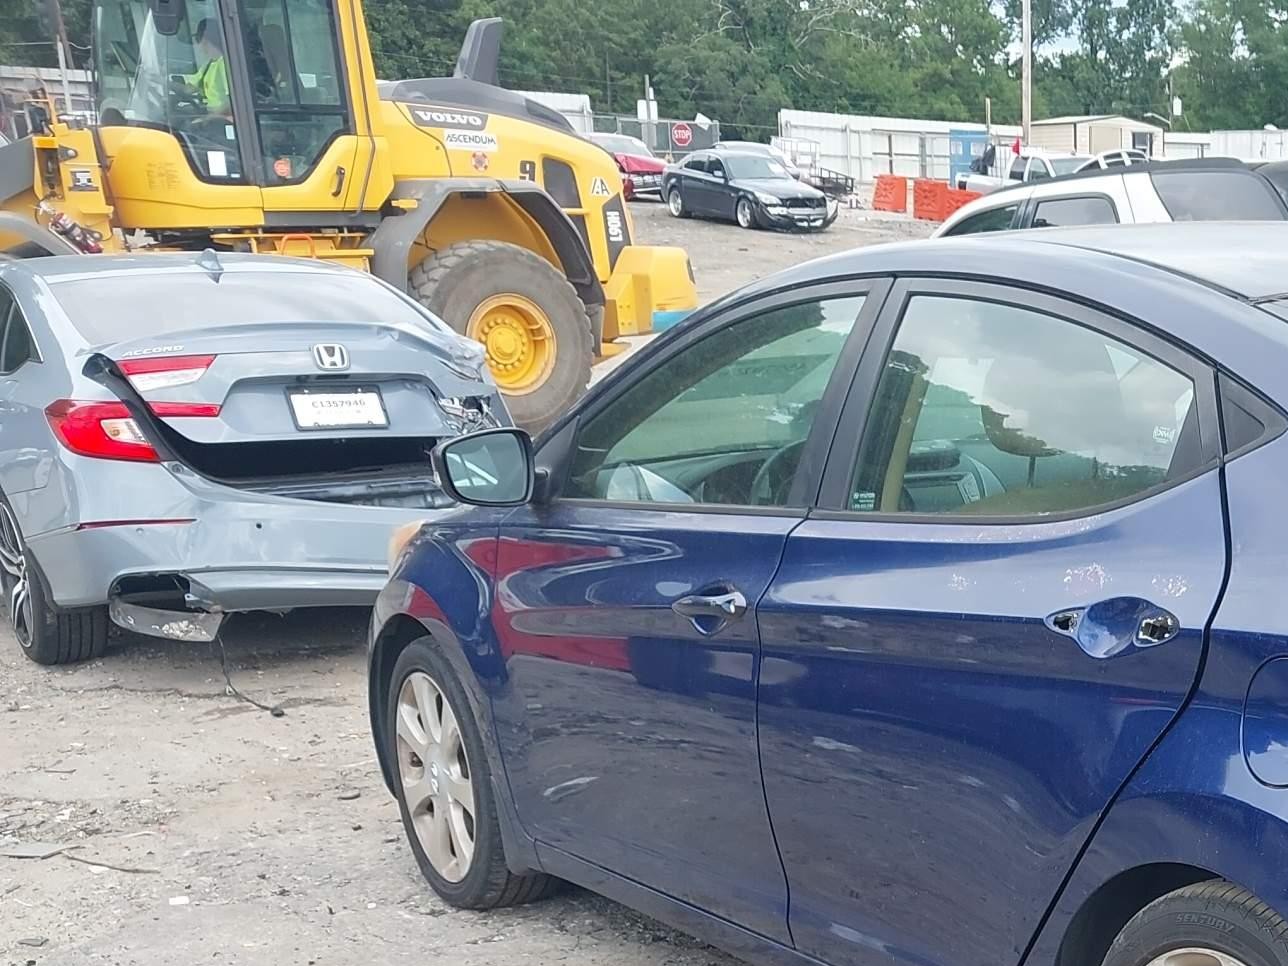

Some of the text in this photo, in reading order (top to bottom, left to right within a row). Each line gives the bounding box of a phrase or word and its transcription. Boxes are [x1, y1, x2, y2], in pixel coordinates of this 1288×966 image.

[414, 110, 482, 126] VOLVO
[446, 133, 497, 145] ASCENDUM
[674, 129, 690, 140] STOP
[519, 159, 536, 182] 9
[606, 211, 623, 242] L90H
[121, 345, 184, 357] ACCORD
[1176, 912, 1235, 934] SENTURY
